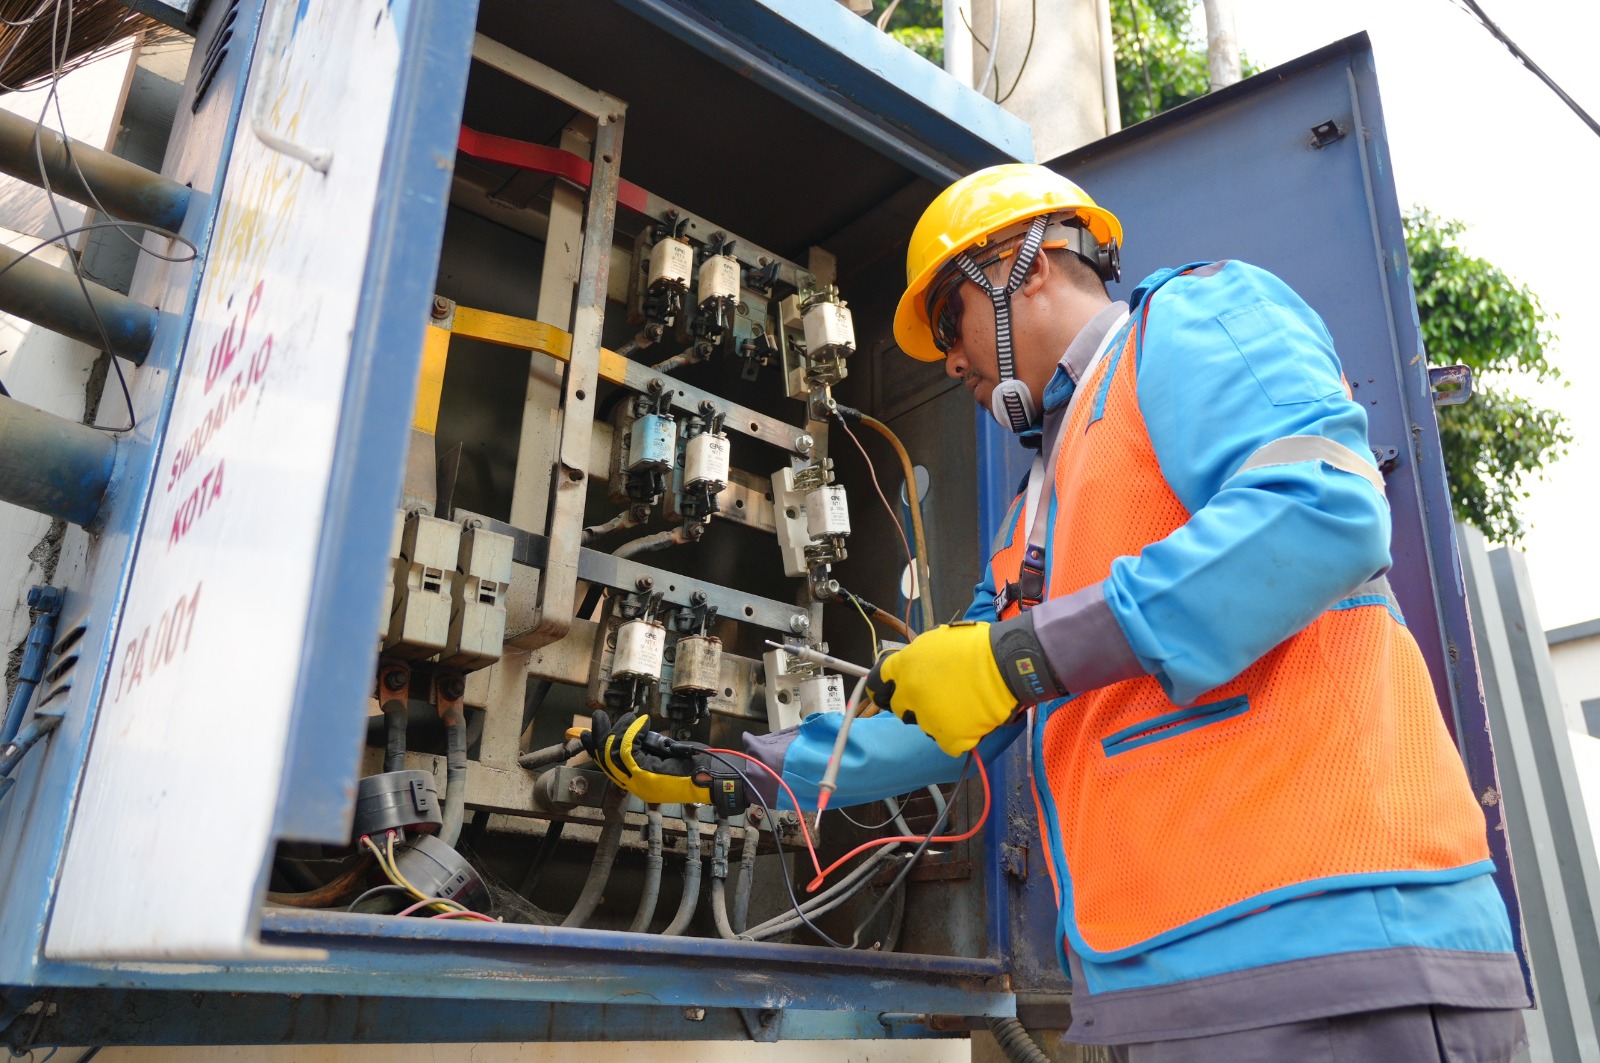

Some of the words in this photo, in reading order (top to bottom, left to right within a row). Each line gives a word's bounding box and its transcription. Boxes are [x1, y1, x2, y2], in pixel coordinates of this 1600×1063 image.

[204, 279, 265, 396] ULP
[167, 332, 273, 492] SIDOARJO
[167, 458, 225, 554] KOTA
